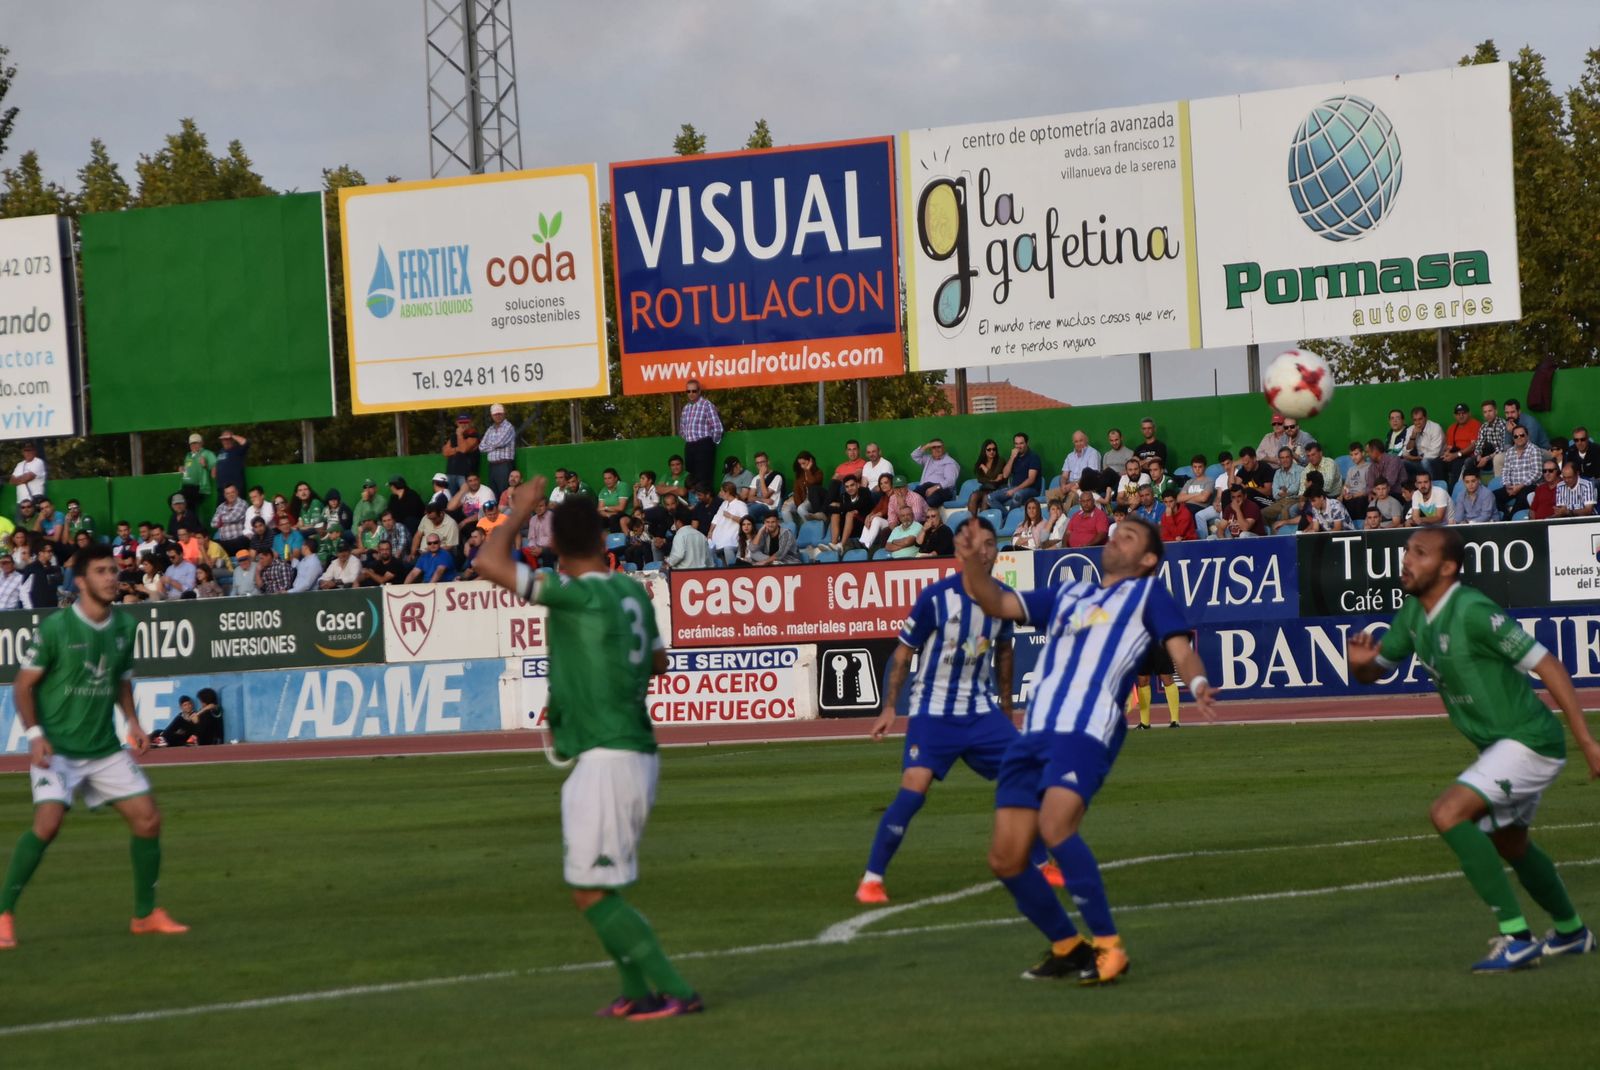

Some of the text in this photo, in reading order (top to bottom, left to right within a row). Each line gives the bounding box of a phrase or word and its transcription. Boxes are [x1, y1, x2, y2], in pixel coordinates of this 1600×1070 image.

[962, 110, 1174, 149] centro de optometría avanzada
[1064, 135, 1175, 159] avda. san francisco 12
[1061, 159, 1177, 180] villanueva de la serena
[979, 167, 1025, 228] la
[624, 170, 882, 268] VISUAL
[0, 255, 52, 277] 42 073
[486, 242, 576, 287] coda
[986, 207, 1180, 305] gafetina
[398, 244, 473, 300] FERTIEX
[1223, 250, 1491, 310] Pormasa
[400, 302, 434, 319] ABONOS
[505, 296, 565, 312] soluciones
[630, 270, 885, 331] ROTULACION
[1353, 296, 1494, 326] autocares
[491, 309, 581, 330] agrosostenibles
[978, 308, 1177, 335] El mundo tiene muchas cosas que ver,
[0, 349, 55, 368] ctora
[991, 337, 1097, 357] no te pierdas ninguna
[640, 346, 884, 381] www.visualrotulos.com
[0, 379, 50, 397] o.com
[413, 362, 544, 390] Tel. 924 81 16 59
[1, 403, 55, 429] vivir
[1332, 535, 1535, 580] Turmo
[680, 574, 801, 616] casor
[1577, 578, 1592, 588] del
[1341, 588, 1383, 611] Café
[219, 610, 282, 631] SEGUROS
[315, 610, 366, 632] Caser
[621, 597, 648, 664] 3
[678, 624, 735, 639] cerámicas
[743, 622, 778, 637] baños
[786, 619, 845, 636] materiales
[849, 620, 875, 635] para
[876, 618, 888, 631] la
[211, 635, 296, 658] INVERSIONES
[328, 633, 363, 641] SEGUROS
[695, 650, 797, 670] SERVICIO
[696, 671, 777, 694] ACERO
[287, 662, 465, 739] ADAME
[650, 697, 796, 722] CIENFUEGOS
